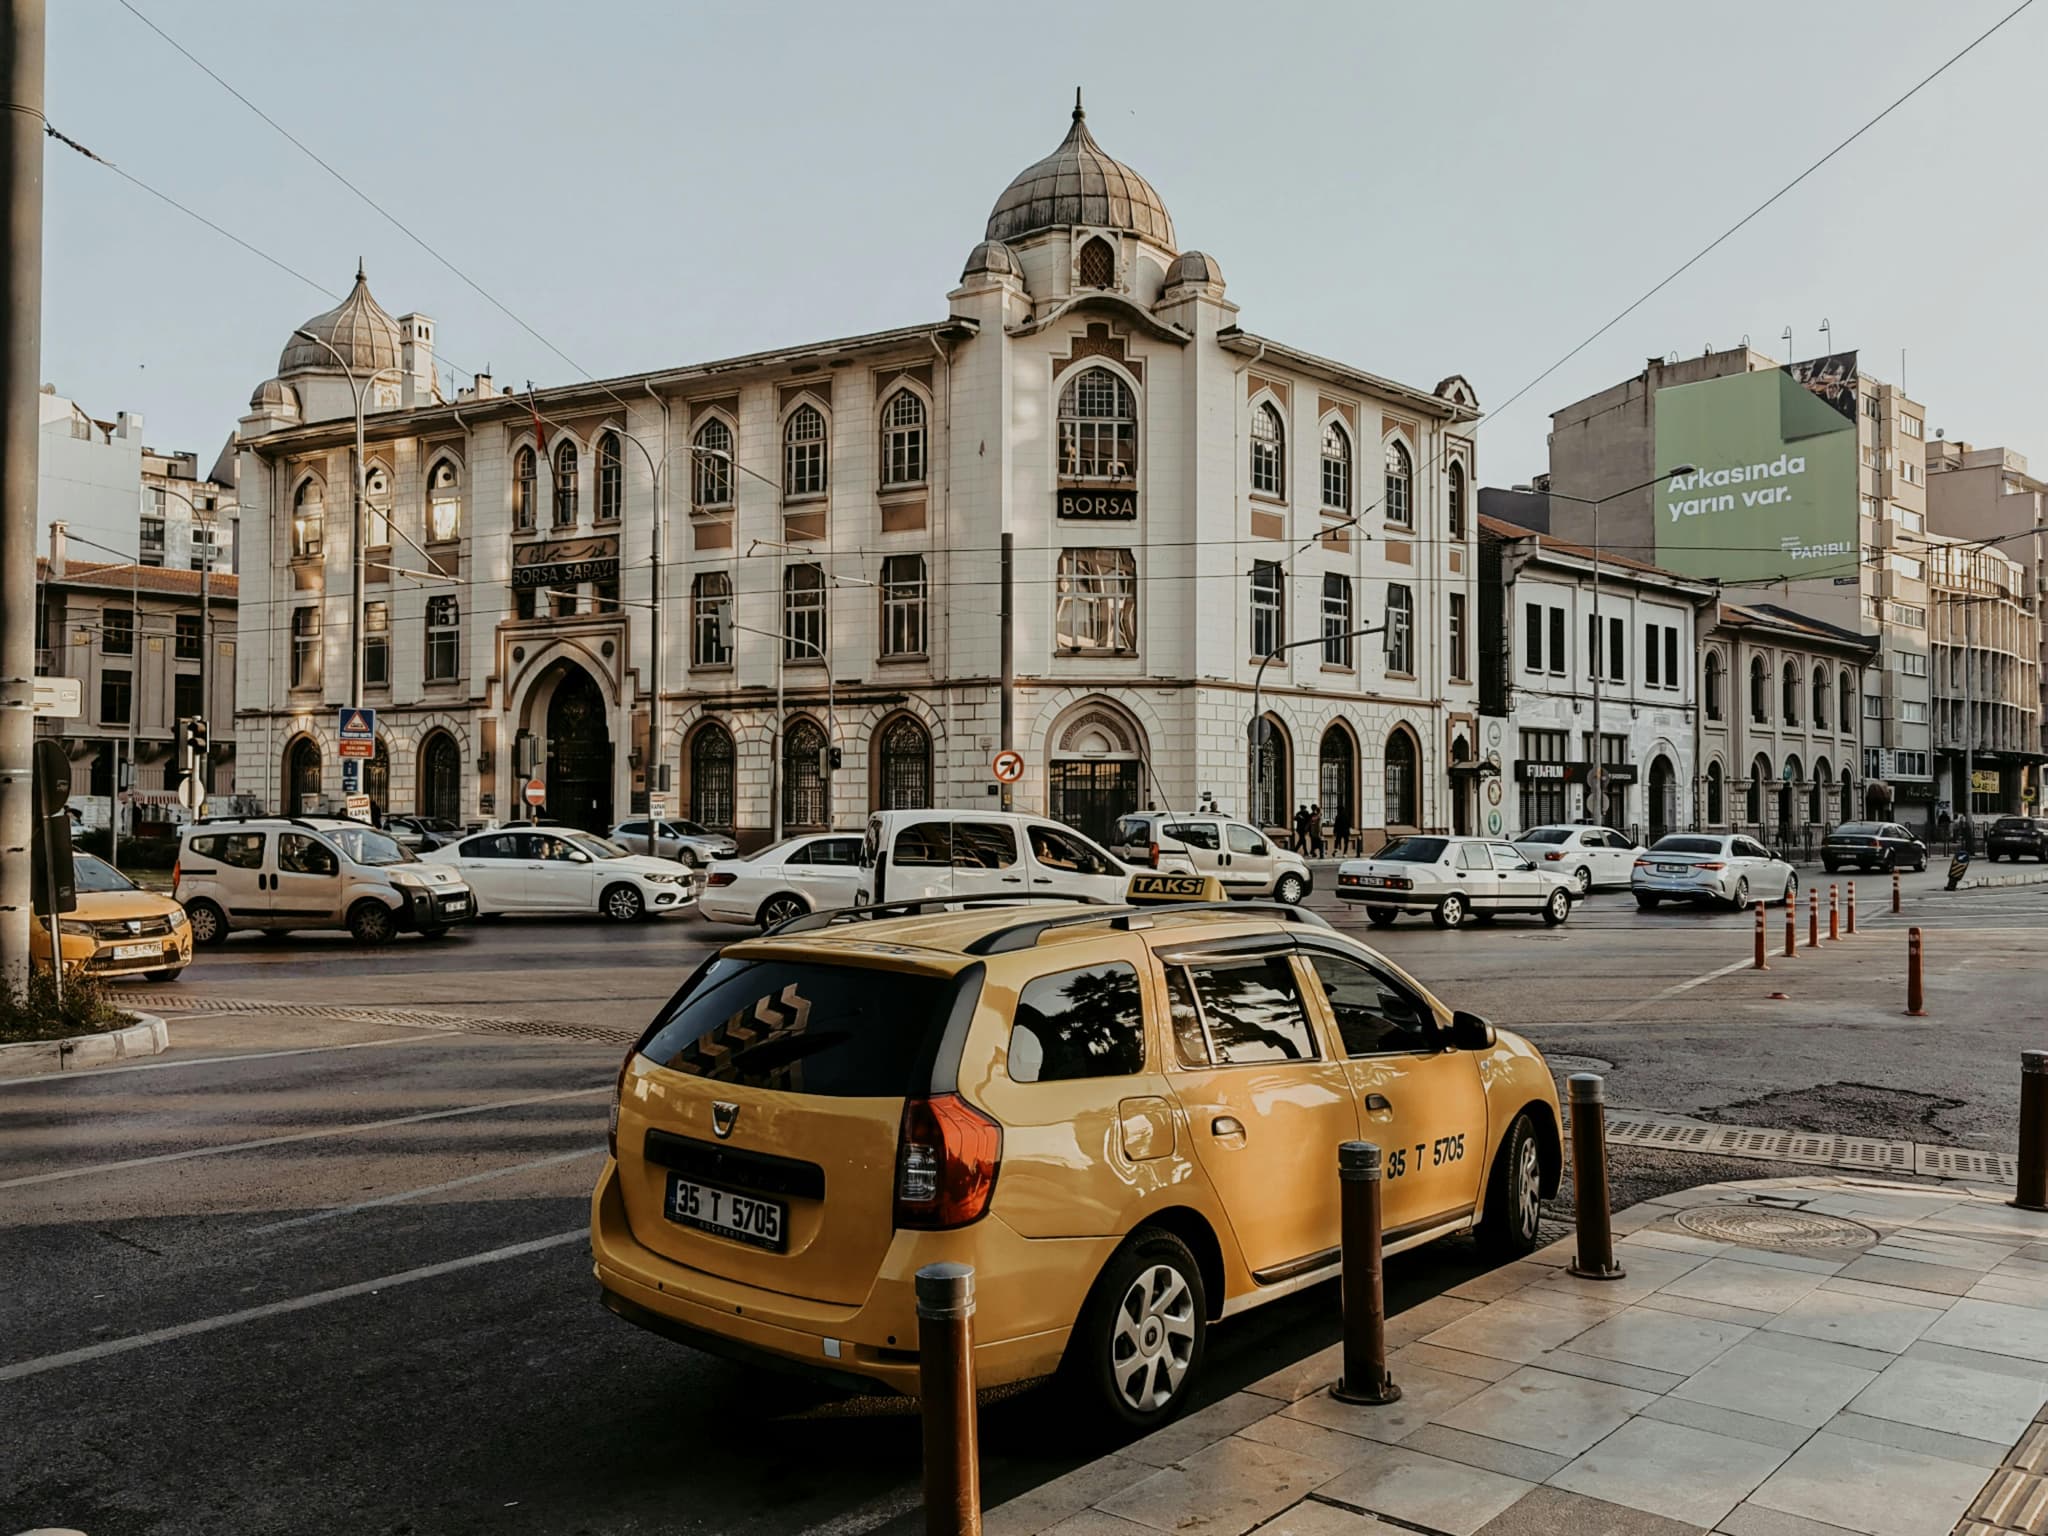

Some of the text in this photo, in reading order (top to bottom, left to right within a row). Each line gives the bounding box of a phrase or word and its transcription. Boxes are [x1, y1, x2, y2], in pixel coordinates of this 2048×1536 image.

[1668, 454, 1806, 493] Arkasında
[1062, 497, 1134, 515] BORSA
[1668, 486, 1792, 522] yarın var.
[513, 567, 559, 584] BORSA
[1387, 1133, 1465, 1179] 35 T 5705
[678, 1183, 700, 1215] 35
[711, 1191, 721, 1221] T
[732, 1198, 777, 1237] 5705
